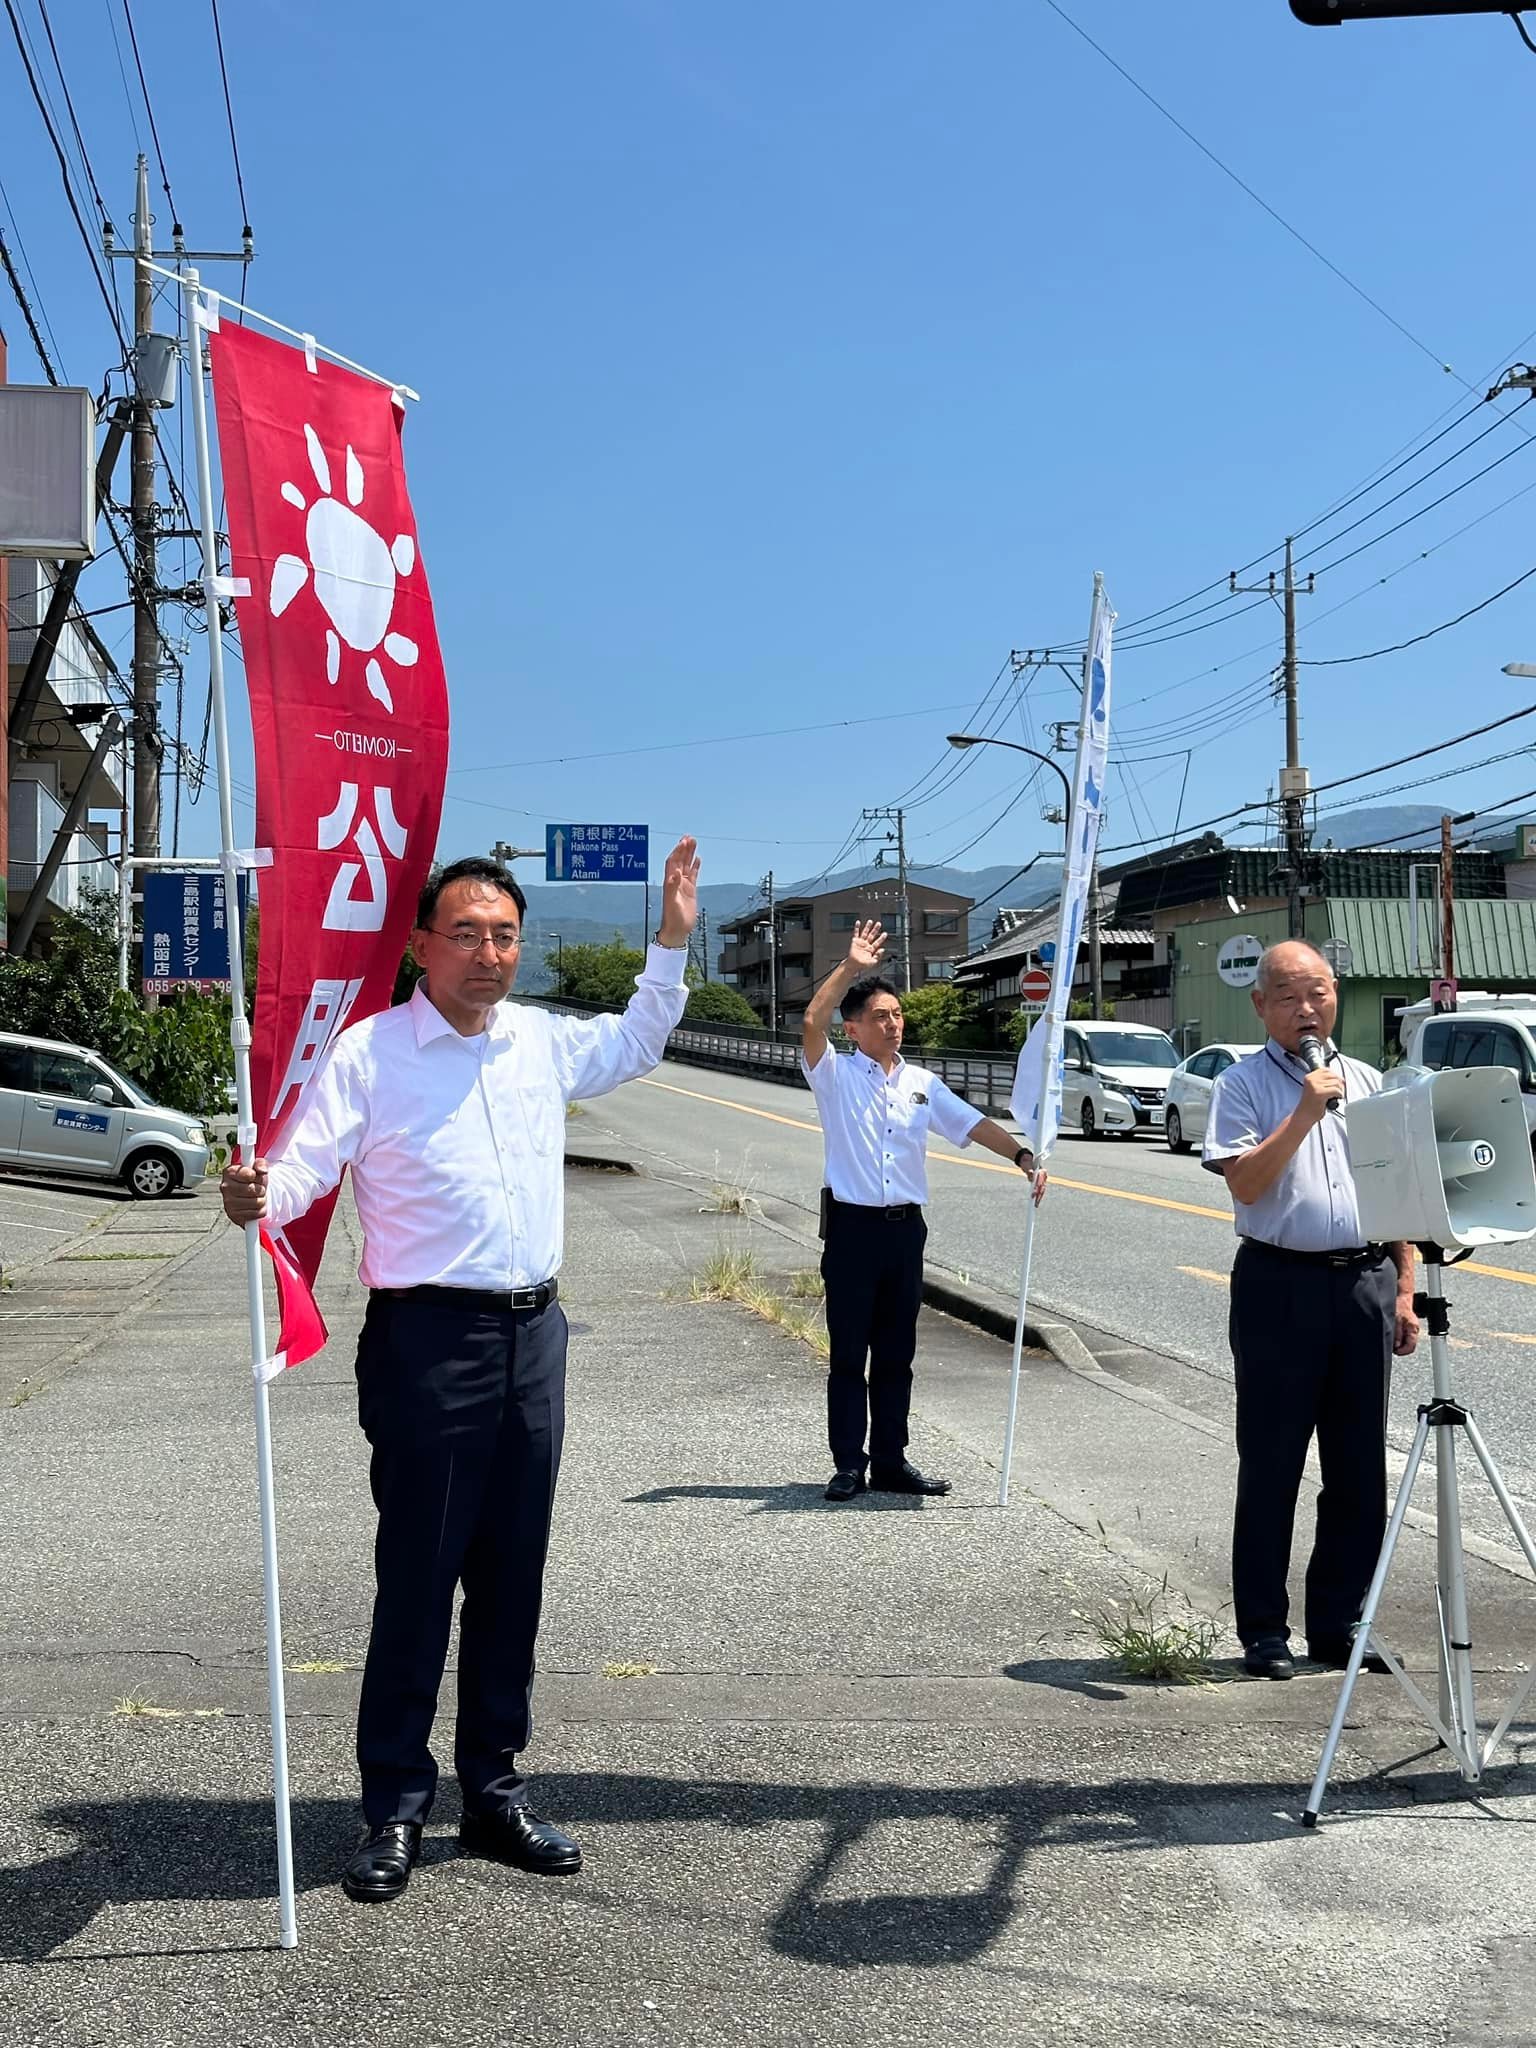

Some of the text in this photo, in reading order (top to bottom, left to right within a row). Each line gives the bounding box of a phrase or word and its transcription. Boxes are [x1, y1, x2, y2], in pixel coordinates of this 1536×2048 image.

[571, 826, 646, 841] 箱根峠 24km
[571, 841, 619, 852] Hakone Pass
[619, 854, 646, 869] 17km
[571, 869, 600, 880] Atami
[183, 876, 200, 977] 三島駅前賃貸センター
